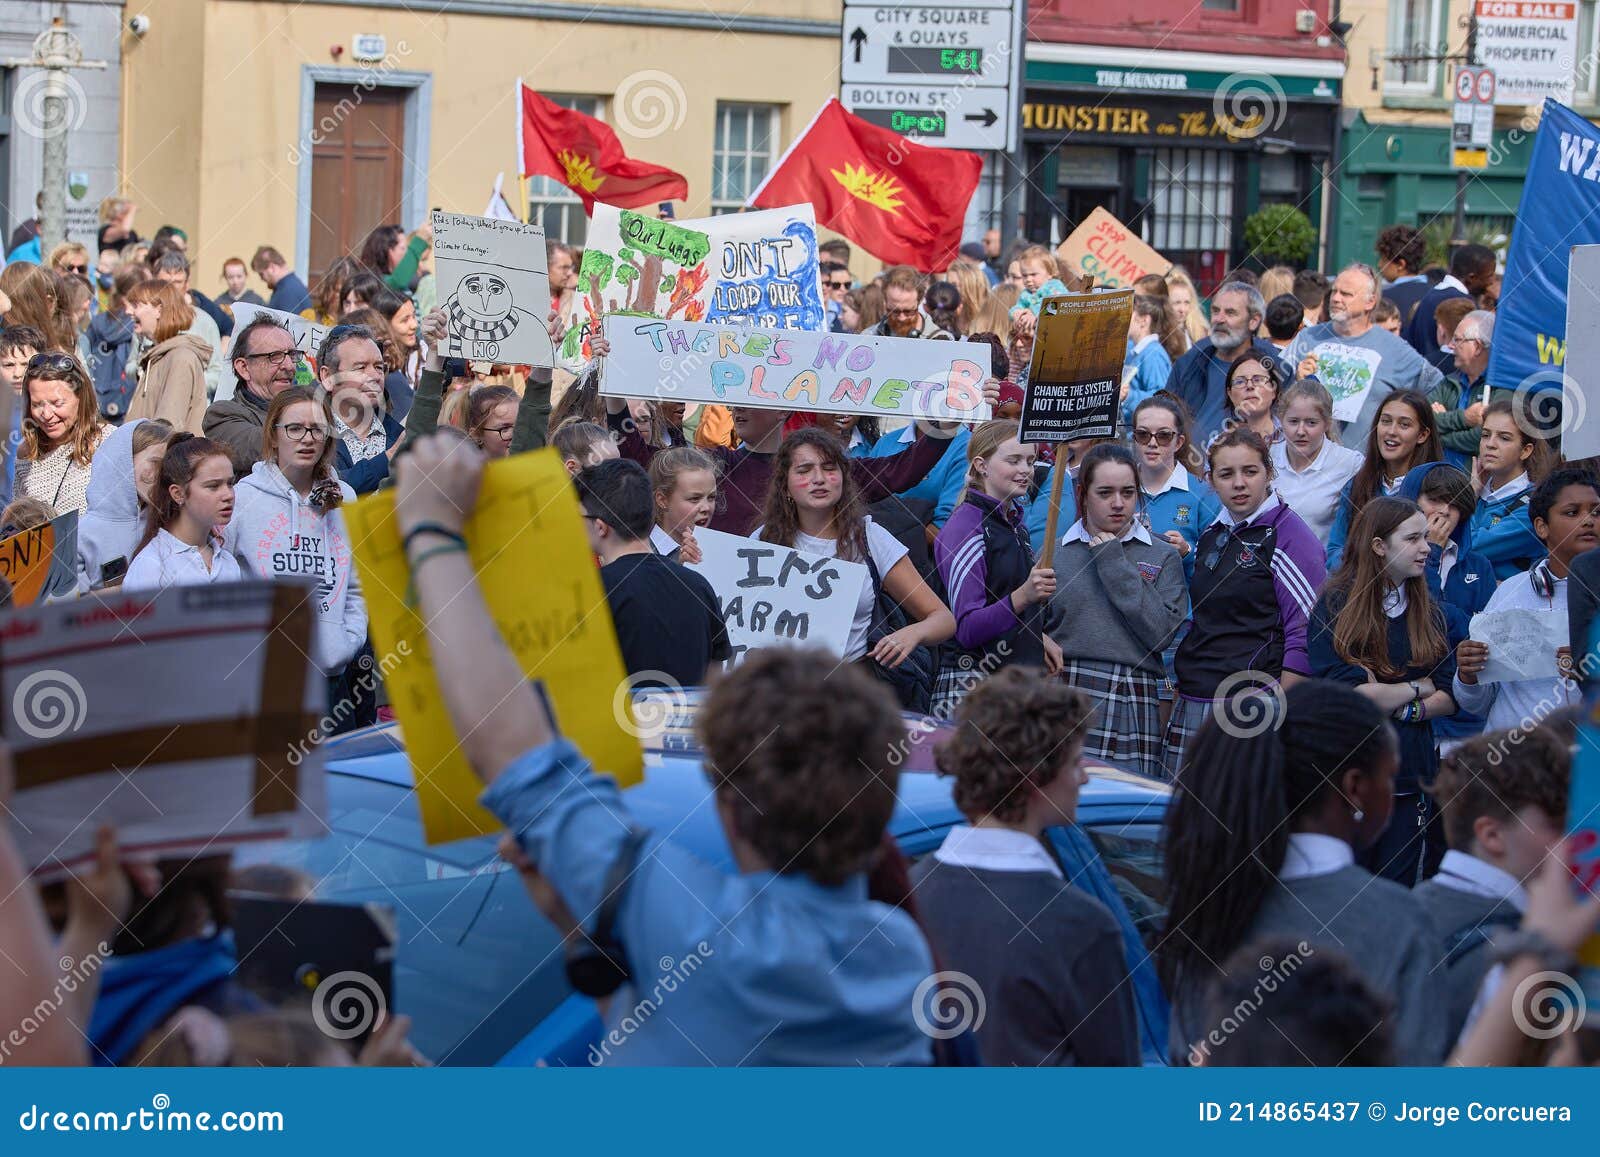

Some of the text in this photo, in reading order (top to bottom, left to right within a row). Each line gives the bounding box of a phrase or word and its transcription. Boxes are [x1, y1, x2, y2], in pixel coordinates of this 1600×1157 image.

[874, 9, 990, 25] CITY SQUARE
[1481, 3, 1566, 18] FOR SALE
[893, 30, 969, 45] & QUAYS
[1476, 25, 1568, 41] COMMERCIAL
[939, 49, 979, 70] 541
[1484, 46, 1556, 62] PROPERTY
[1096, 70, 1188, 90] THE MUNSTER
[851, 89, 948, 106] BOLTON ST
[433, 213, 450, 225] Kids
[434, 239, 461, 250] Climate
[627, 218, 701, 268] Our Lungs
[714, 282, 803, 312] LOOD OUR
[472, 340, 500, 361] NO
[811, 335, 877, 373] NO
[709, 358, 984, 413] PLANET B
[1033, 385, 1068, 397] CHANGE
[1070, 384, 1084, 397] THE
[1031, 393, 1113, 412] NOT THE CLIMATE
[1028, 419, 1044, 427] KEEP
[1043, 419, 1061, 428] FOSSIL
[1061, 419, 1076, 428] FUELS
[717, 594, 810, 641] ARM
